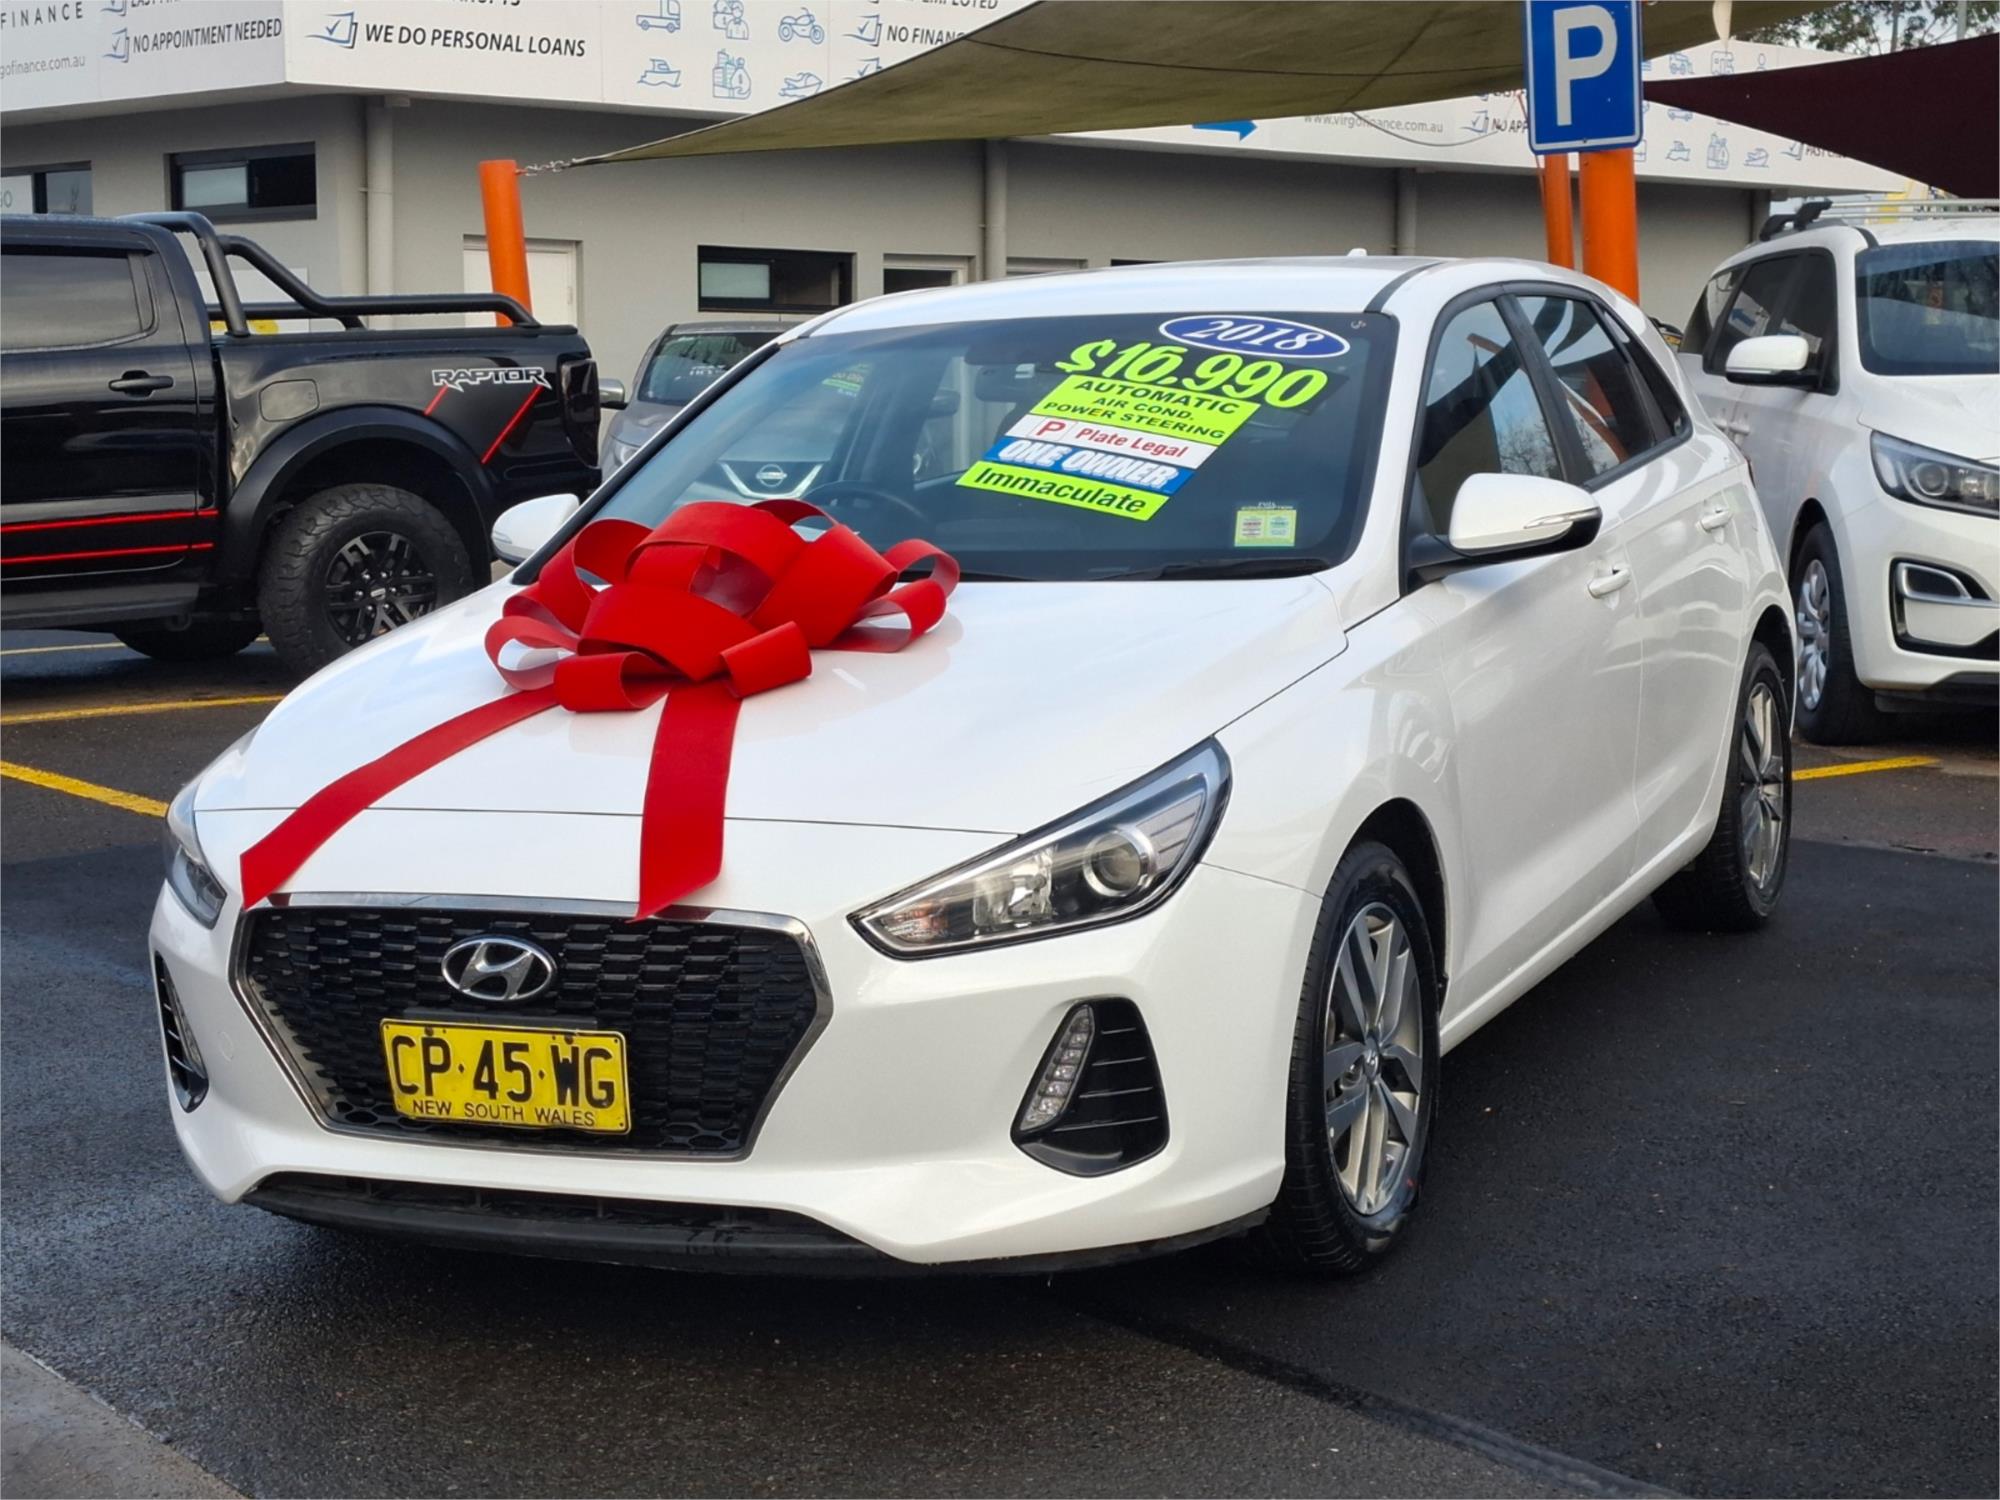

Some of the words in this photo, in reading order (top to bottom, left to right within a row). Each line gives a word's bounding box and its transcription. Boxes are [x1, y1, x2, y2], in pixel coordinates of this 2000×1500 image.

[0, 2, 83, 29] FINANCE
[133, 34, 150, 53] NO
[151, 24, 232, 51] APPOINTMENT
[234, 18, 282, 40] NEEDED
[365, 24, 393, 43] WE
[399, 26, 426, 45] DO
[431, 29, 524, 53] PERSONAL
[528, 36, 586, 57] LOANS
[887, 25, 909, 43] NO
[1553, 5, 1618, 126] P
[1182, 320, 1325, 350] 2018
[432, 367, 552, 392] RAPTOR
[1074, 380, 1240, 414] AUTOMATIC
[1092, 398, 1129, 408] AIR
[1134, 404, 1195, 420] COND.
[1043, 402, 1117, 419] POWER
[1120, 411, 1226, 439] STEERING
[1036, 421, 1066, 436] P
[1076, 428, 1127, 446] Plate
[1130, 437, 1189, 457] Legal
[998, 440, 1072, 466] ONE
[1061, 450, 1179, 488] OWNER
[975, 468, 1146, 514] Immaculate
[412, 1100, 452, 1115] NEW
[464, 1102, 524, 1121] SOUTH
[535, 1107, 595, 1126] WALES
